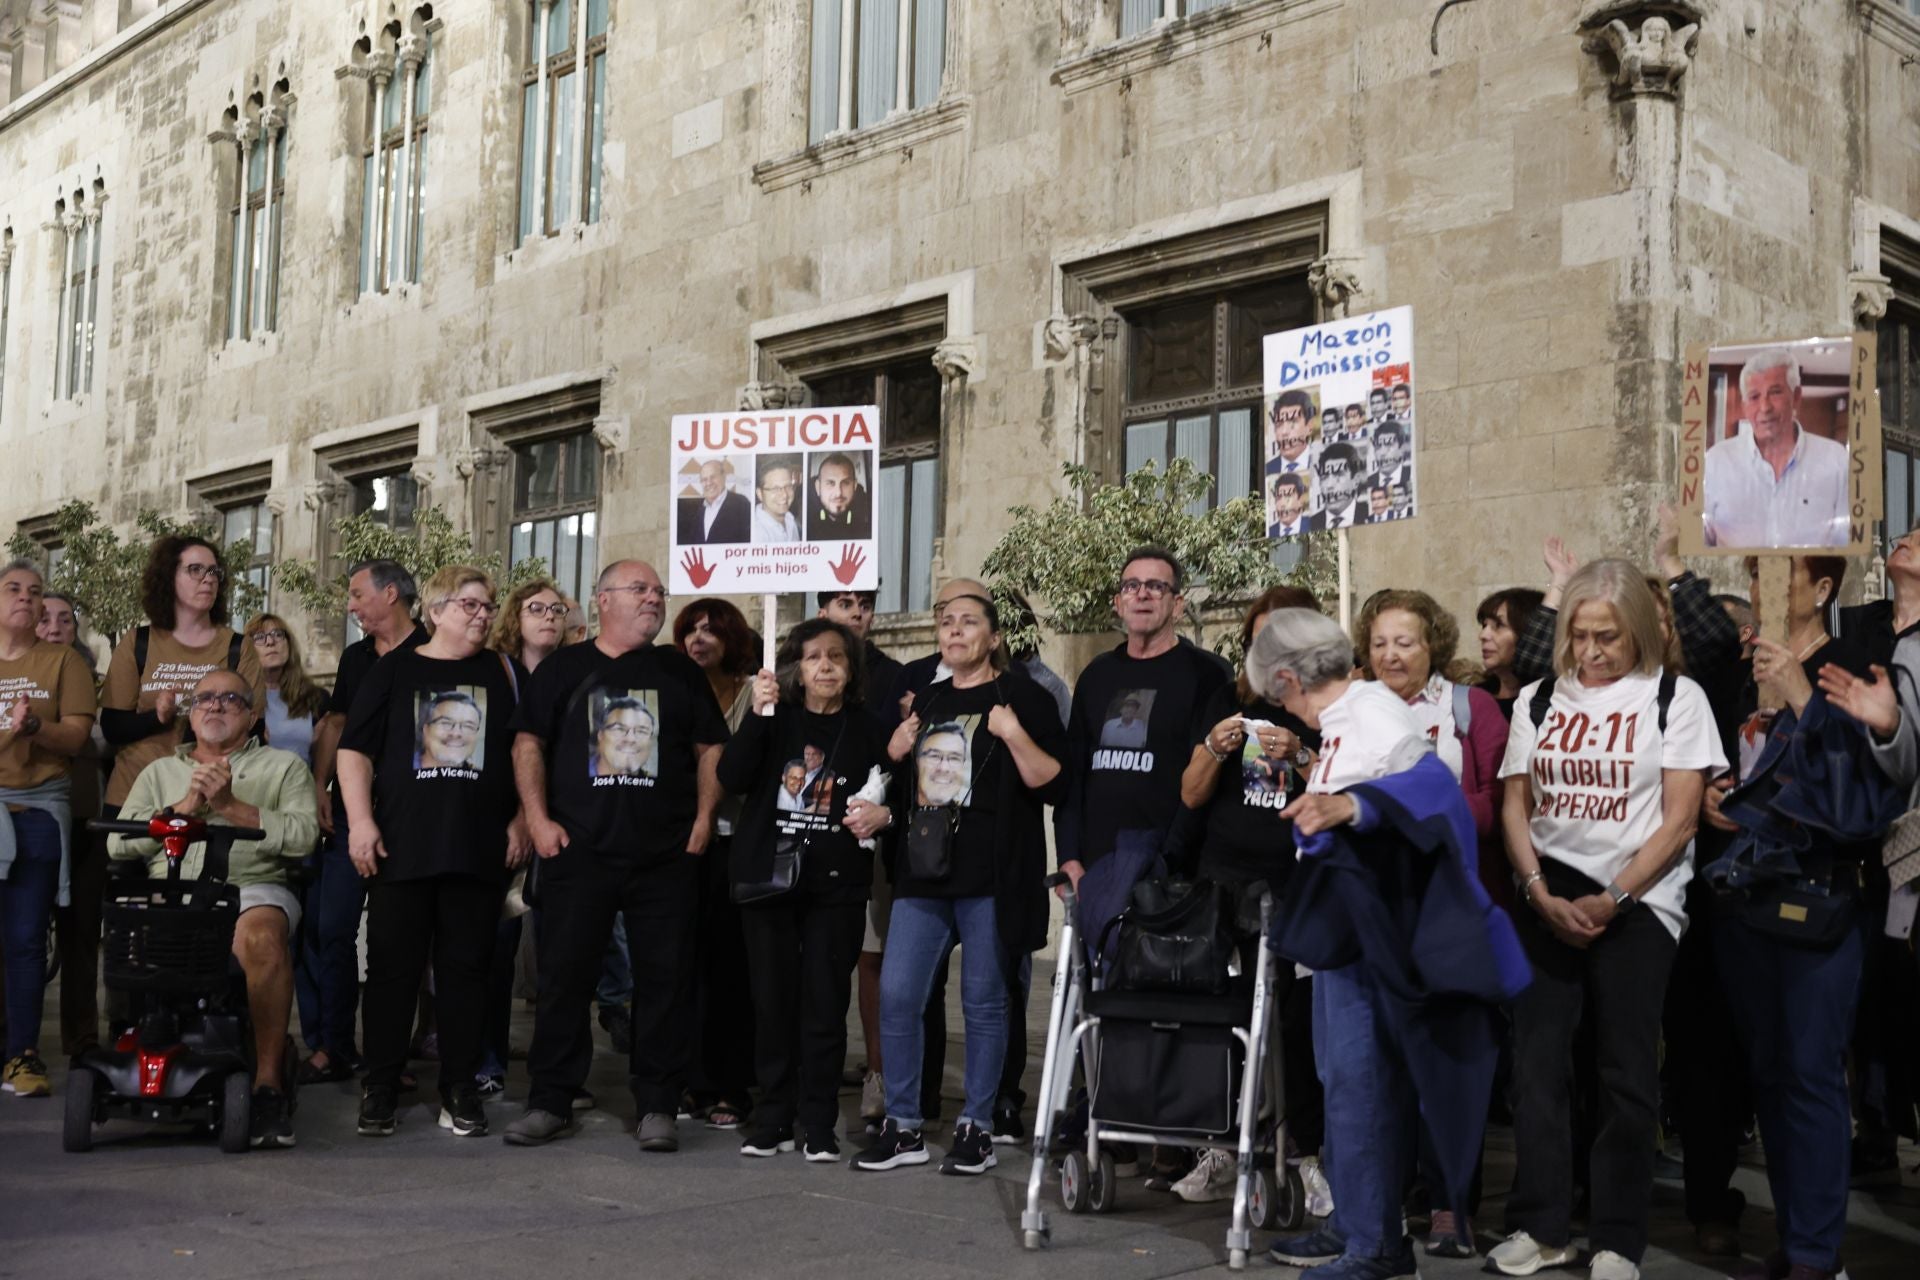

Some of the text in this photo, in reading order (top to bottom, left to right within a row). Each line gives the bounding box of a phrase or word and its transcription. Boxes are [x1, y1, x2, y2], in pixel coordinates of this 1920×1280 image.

[1300, 314, 1392, 357] Mazón
[1279, 342, 1392, 387] Dimissió
[678, 412, 873, 452] JUSTICIA
[1682, 361, 1702, 506] MAZÓN
[725, 544, 820, 559] por mi marido
[736, 562, 808, 577] y mis hijos
[1537, 711, 1639, 753] 20:11
[441, 767, 479, 780] Vicente
[617, 774, 655, 787] Vicente
[1534, 757, 1634, 789] NI OBLIT
[1554, 791, 1630, 823] PERDÓ
